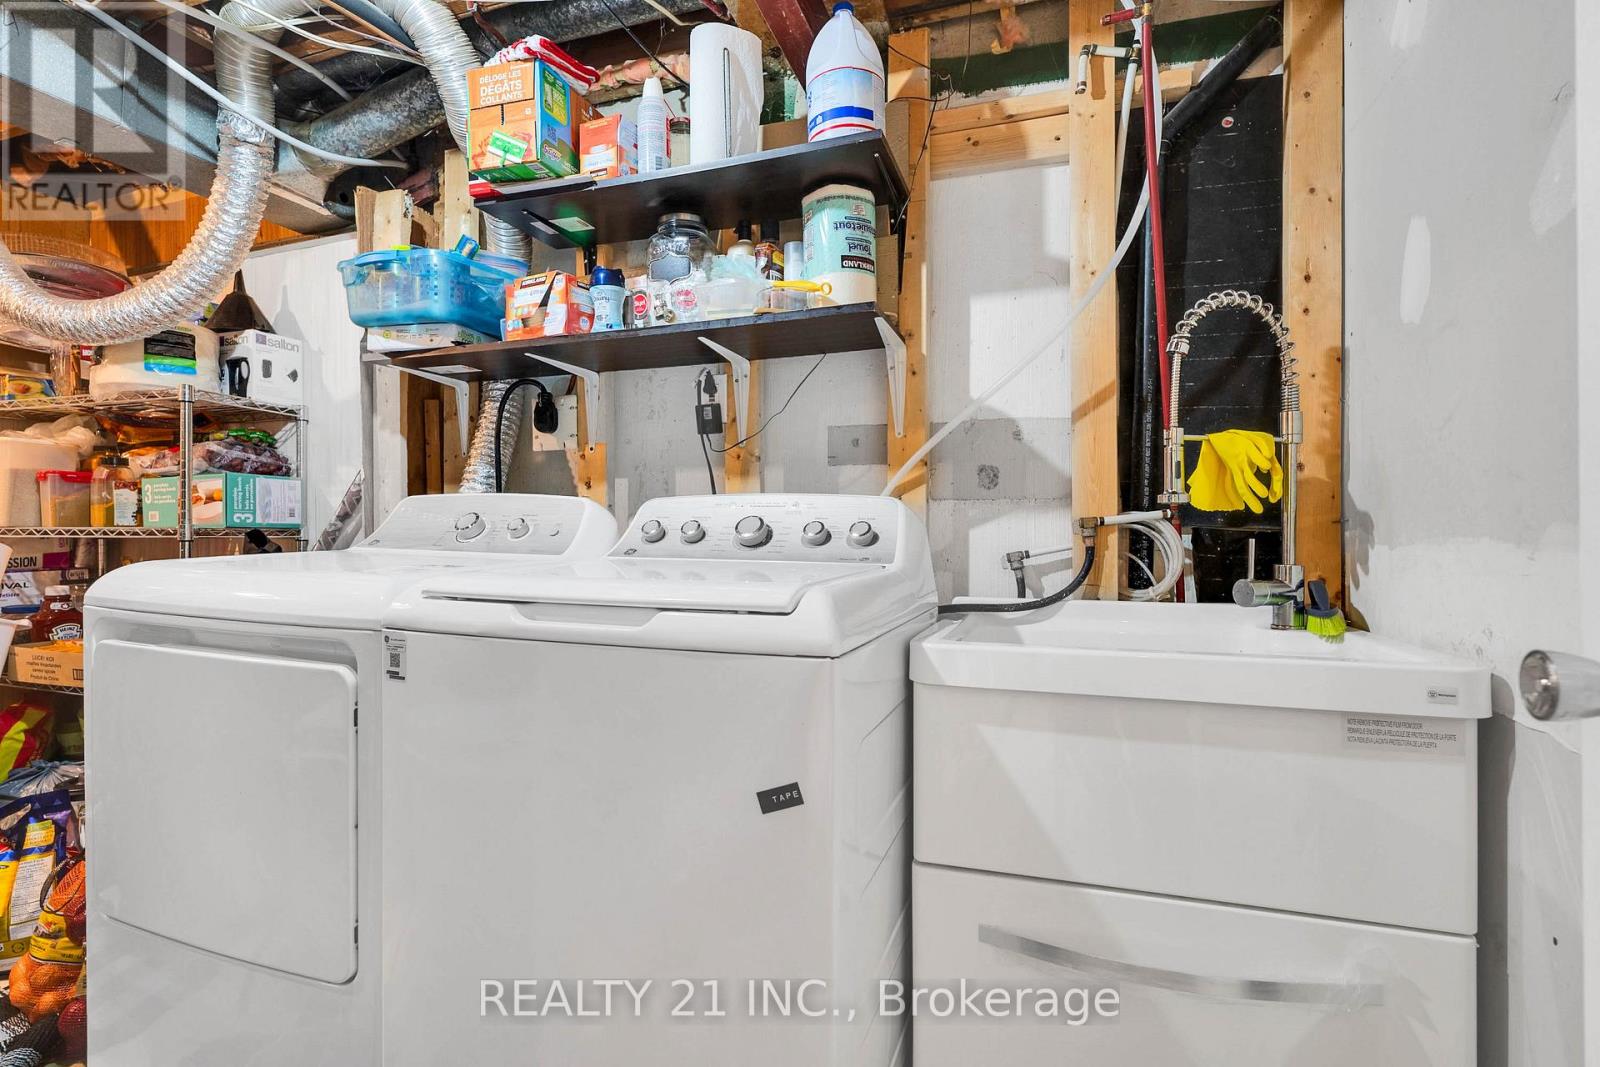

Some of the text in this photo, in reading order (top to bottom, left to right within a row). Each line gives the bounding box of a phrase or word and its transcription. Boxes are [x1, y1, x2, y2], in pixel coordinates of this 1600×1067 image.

[509, 69, 521, 79] LES
[480, 92, 522, 105] COLLANTS
[224, 335, 248, 347] salton
[267, 338, 300, 352] salton
[144, 484, 152, 504] 3
[233, 512, 254, 523] 3
[771, 790, 800, 803] TAPE
